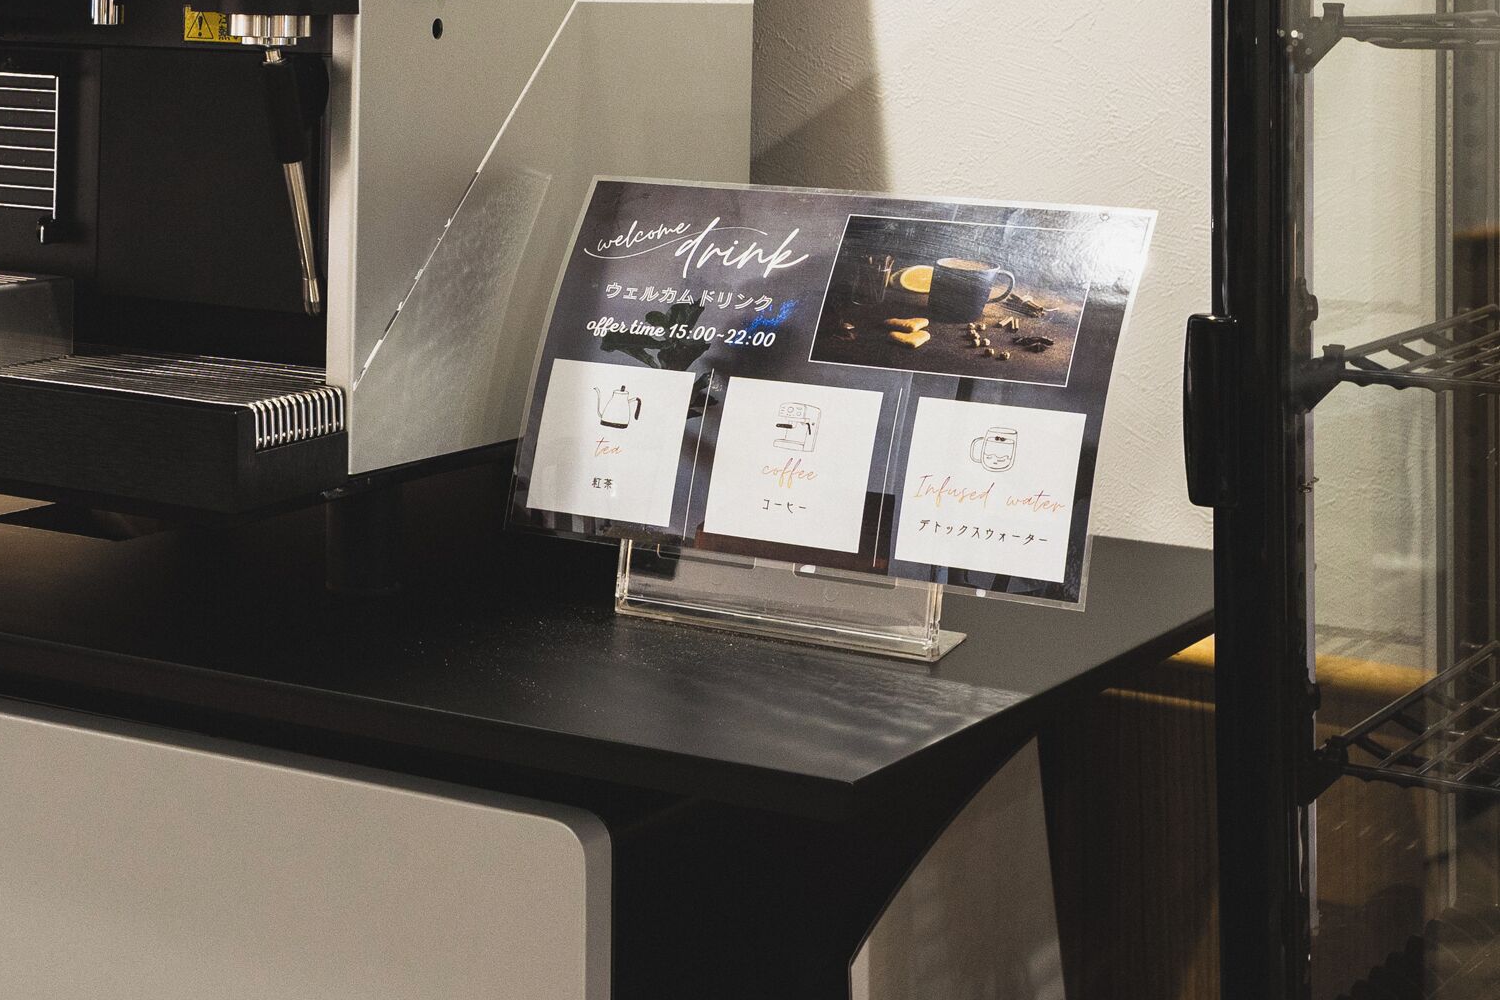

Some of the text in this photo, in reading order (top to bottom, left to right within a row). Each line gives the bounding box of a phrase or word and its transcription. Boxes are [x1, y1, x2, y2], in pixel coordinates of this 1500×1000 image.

[596, 216, 810, 279] welcome drink
[605, 281, 774, 312] ウェルカムドリンク
[586, 316, 777, 348] offer time 15:00~22:00
[594, 436, 623, 457] tea
[591, 477, 614, 490] 紅茶
[762, 457, 819, 489] coffee
[762, 498, 807, 514] コーヒー
[912, 474, 1067, 513] Infused water
[918, 518, 1049, 546] デトックスウォーター
